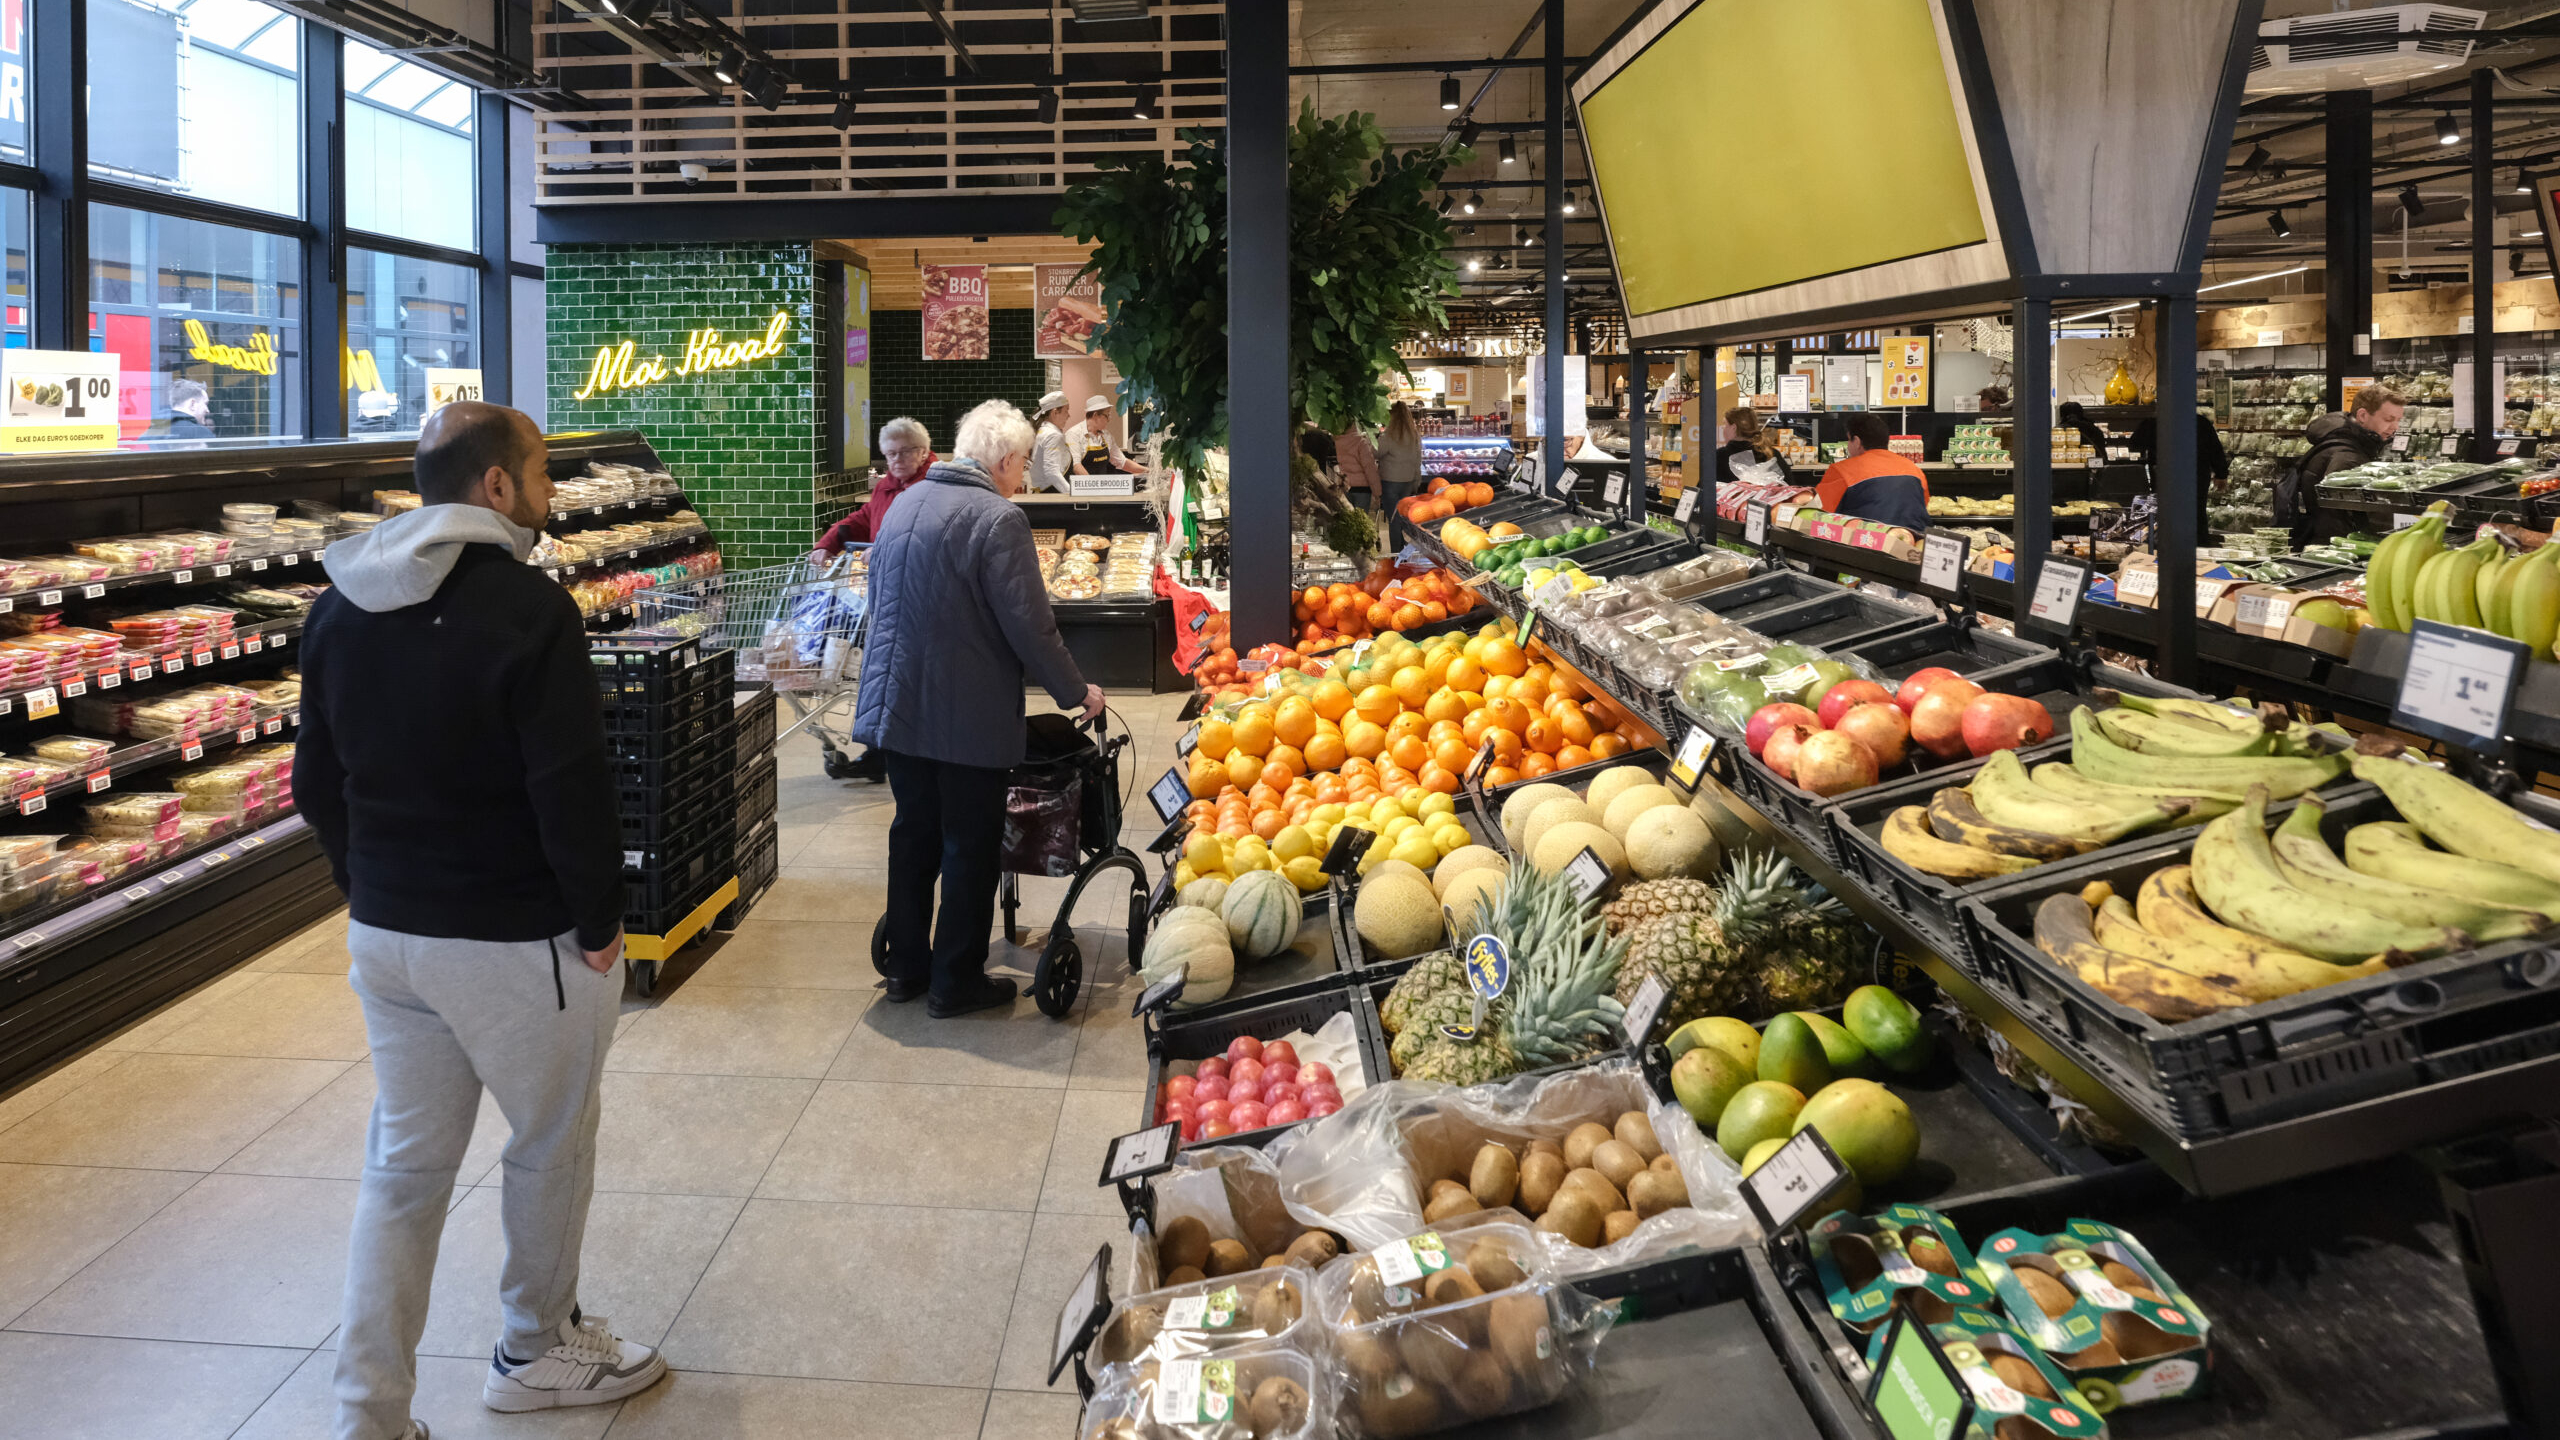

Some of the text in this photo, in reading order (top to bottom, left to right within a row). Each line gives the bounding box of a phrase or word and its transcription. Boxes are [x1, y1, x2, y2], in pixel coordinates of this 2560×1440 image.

[949, 277, 982, 296] BBQ
[1042, 286, 1094, 296] CARPACCIO
[574, 341, 668, 400] Moi
[1100, 479, 1130, 488] BROODJES
[1471, 941, 1499, 986] Fyffes
